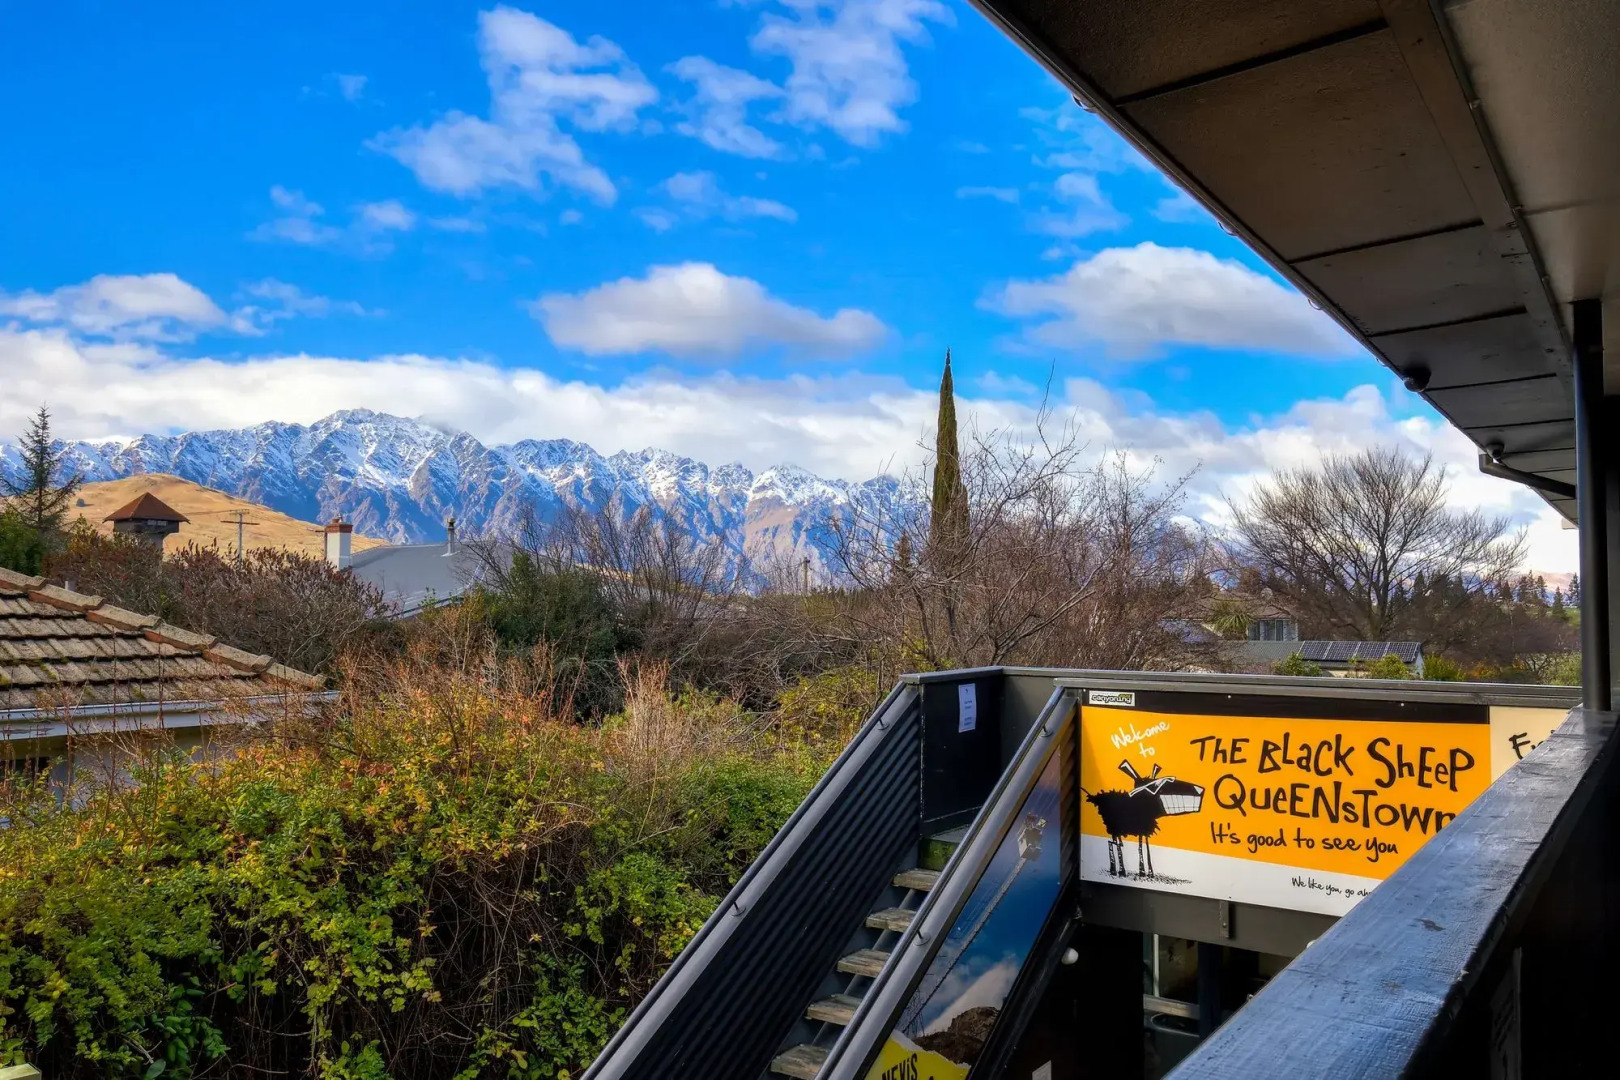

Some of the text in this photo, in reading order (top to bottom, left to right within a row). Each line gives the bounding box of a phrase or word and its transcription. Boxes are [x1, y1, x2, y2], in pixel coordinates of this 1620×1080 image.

[1111, 721, 1170, 749] Welcome
[1139, 742, 1156, 758] to
[1210, 821, 1399, 863] It's good to see you
[1291, 876, 1306, 888] We
[1308, 877, 1324, 890] like
[1345, 888, 1355, 898] go
